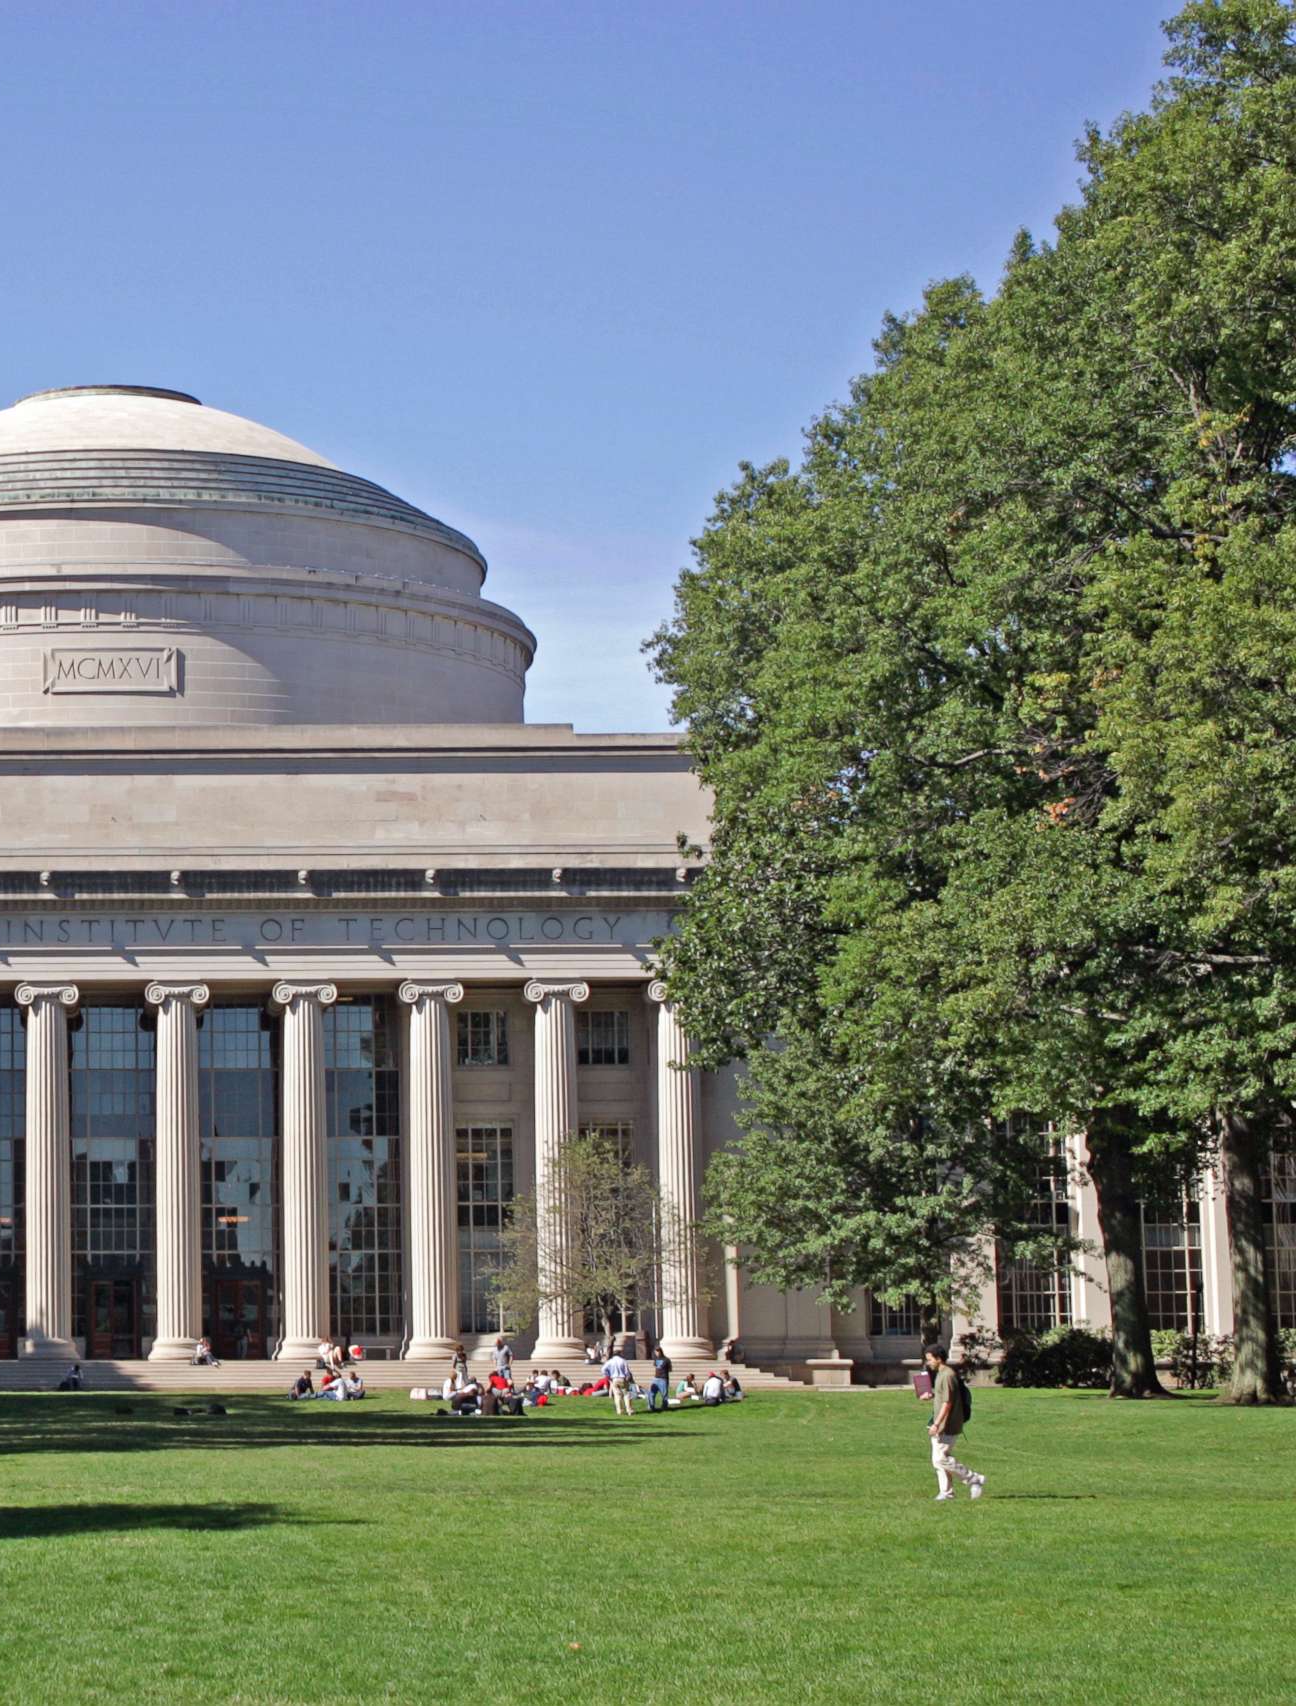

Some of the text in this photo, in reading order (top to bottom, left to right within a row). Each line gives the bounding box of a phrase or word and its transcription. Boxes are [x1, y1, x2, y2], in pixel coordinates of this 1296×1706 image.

[57, 657, 161, 680] MCMXVI
[6, 918, 227, 944] INSTITVTE
[259, 917, 306, 943] OF
[338, 916, 622, 942] TECHNOLOGY
